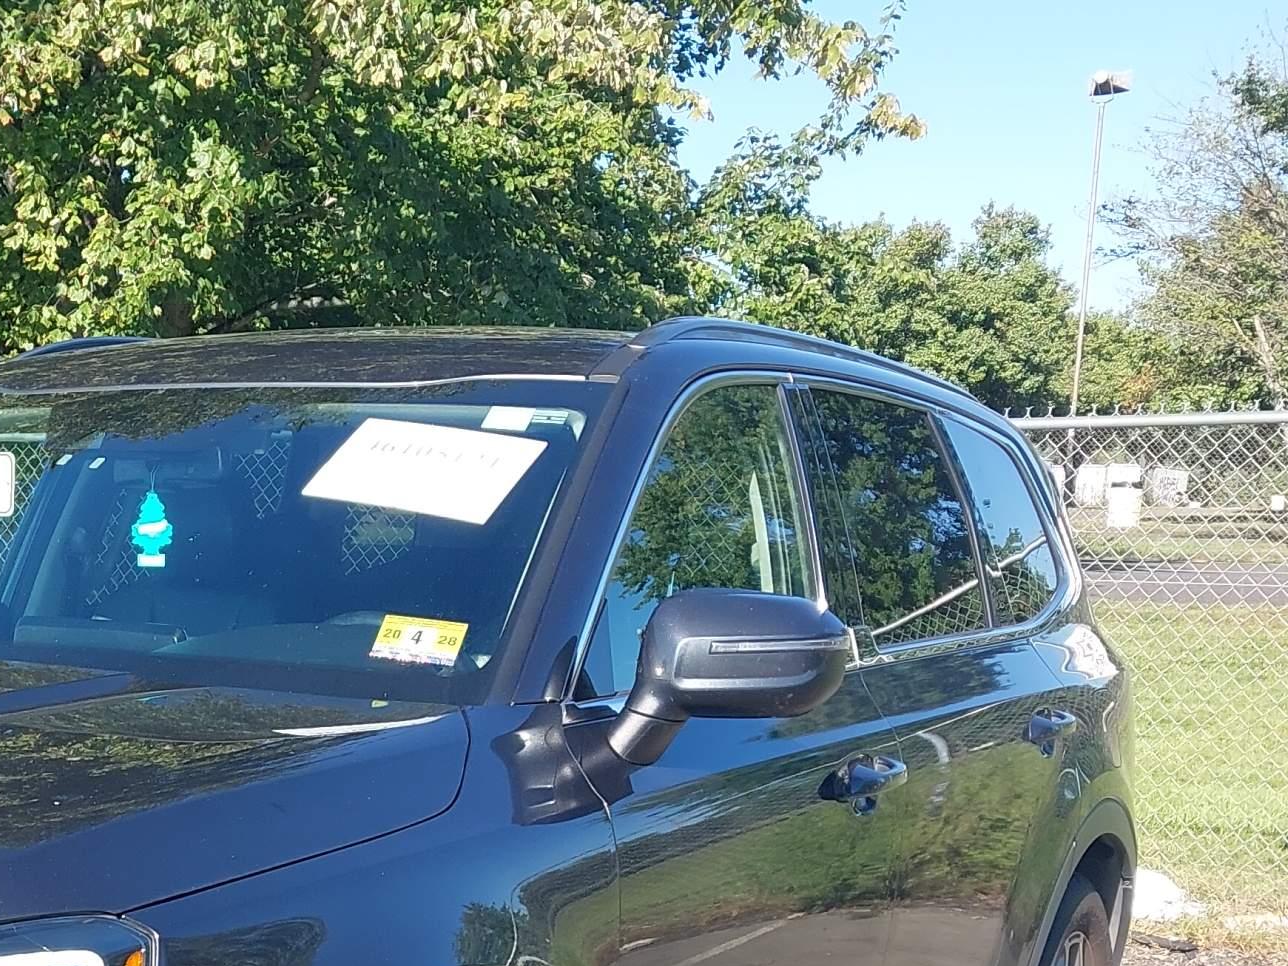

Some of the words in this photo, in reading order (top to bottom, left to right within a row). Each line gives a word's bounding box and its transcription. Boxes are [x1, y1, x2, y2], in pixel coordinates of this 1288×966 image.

[383, 628, 402, 639] 20
[411, 630, 423, 644] 4
[437, 635, 458, 646] 28
